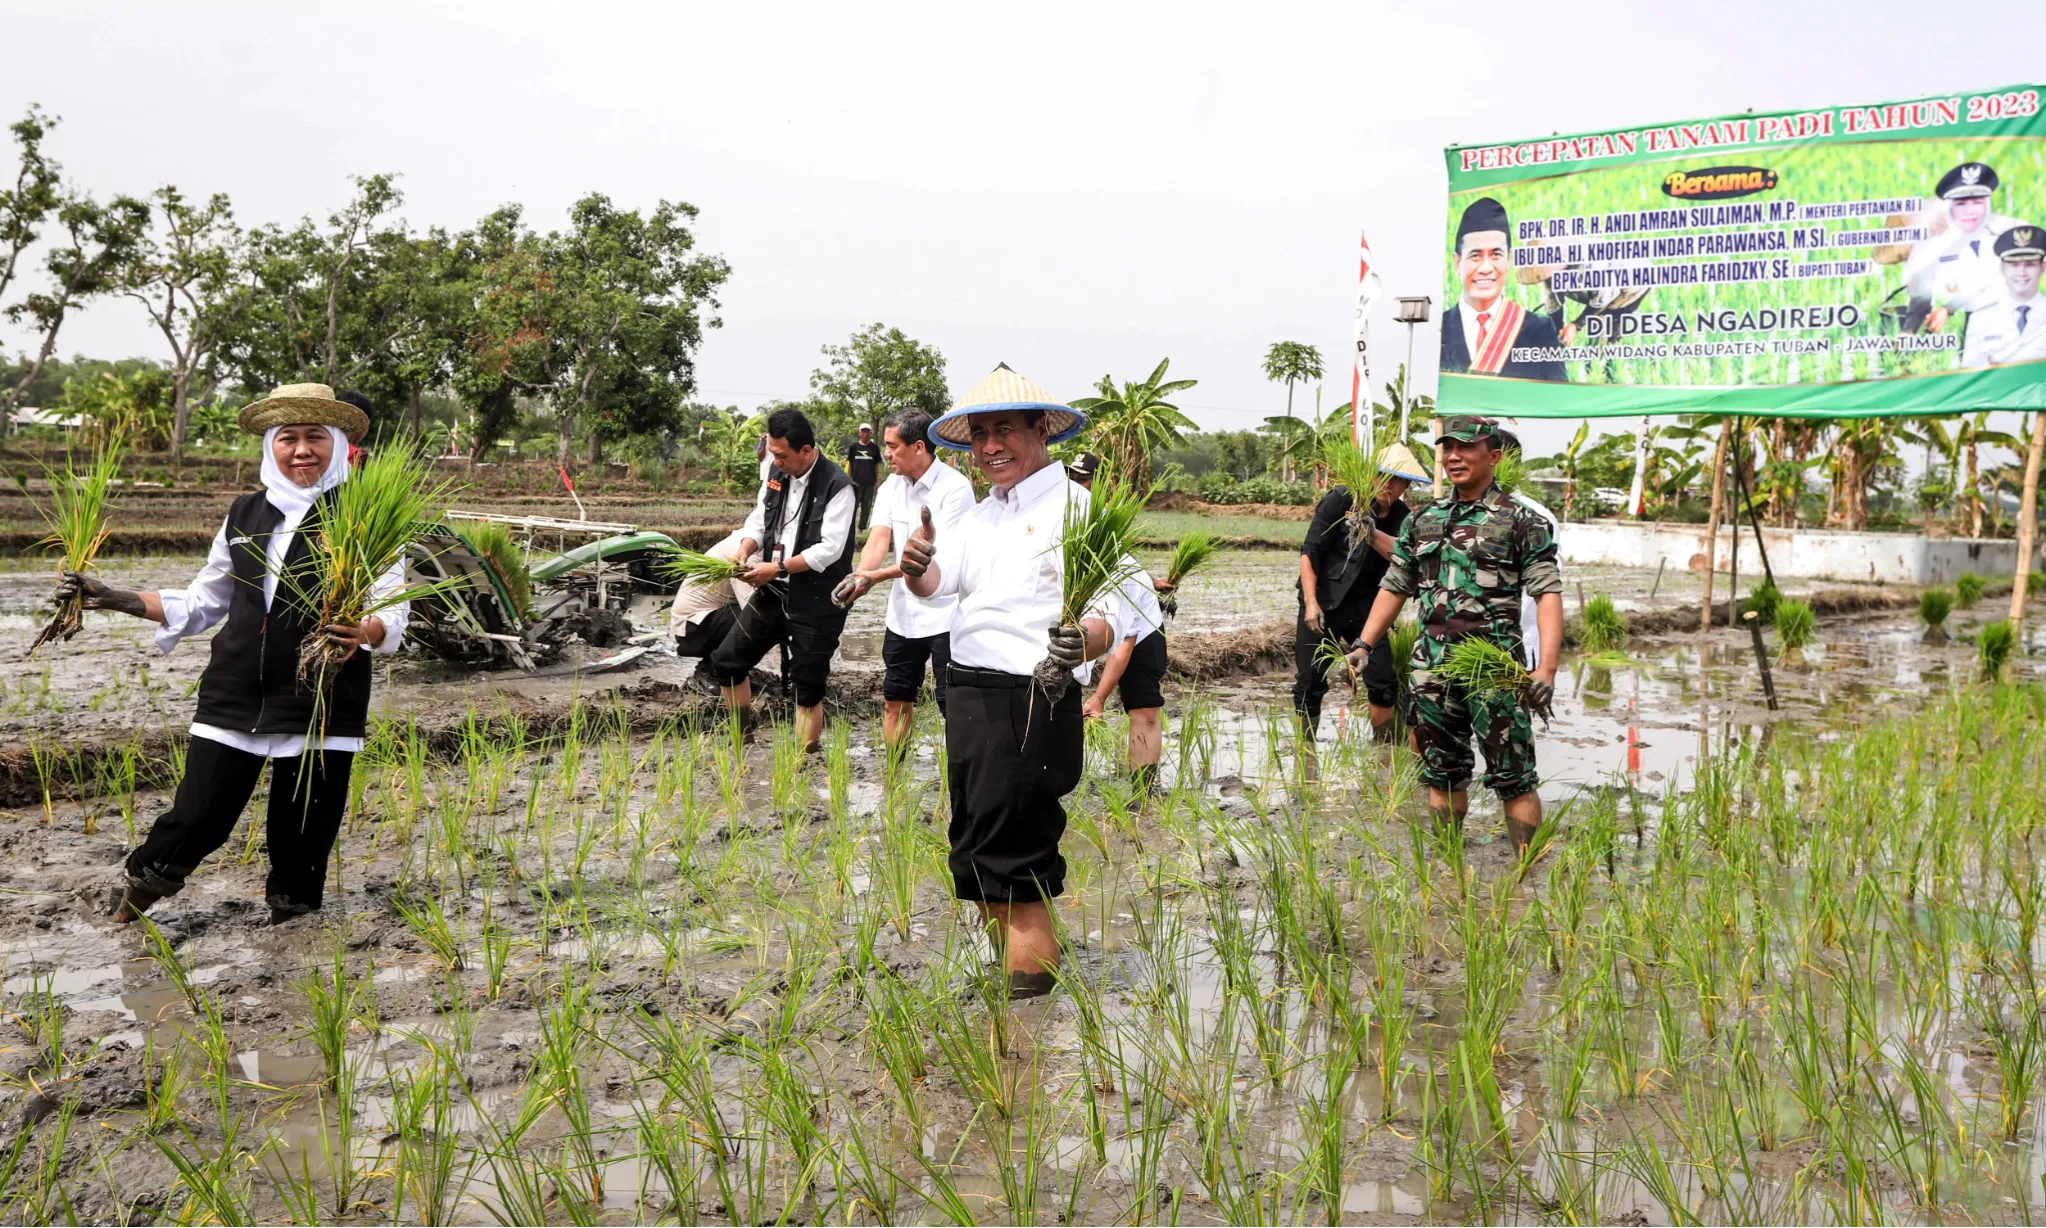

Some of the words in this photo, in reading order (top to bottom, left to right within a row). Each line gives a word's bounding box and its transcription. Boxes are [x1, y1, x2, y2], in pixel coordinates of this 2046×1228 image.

[1461, 134, 1636, 170] PERCEPATAN
[1645, 122, 1747, 152] TANAM
[1758, 113, 1833, 140] PADI
[1842, 100, 1958, 132] TAHUN
[1969, 92, 2037, 120] 2023
[1519, 221, 1546, 239] BPK.
[1549, 219, 1568, 237] DR.
[1572, 218, 1587, 235] IR.
[1590, 216, 1601, 234] H.
[1605, 213, 1636, 233] ANDI
[1639, 209, 1687, 230] AMRAN
[1691, 204, 1765, 227] SULAIMAN,
[1769, 202, 1795, 221] M.P.
[1805, 204, 1846, 219] MENTERI
[1849, 200, 1902, 216] PERTANIAN
[1905, 199, 1916, 212] RI
[1514, 248, 1534, 266] IBU
[1537, 246, 1565, 264] DRA.
[1568, 244, 1585, 262] HJ.
[1588, 240, 1649, 262] KHOFIFAH
[1653, 237, 1694, 257] INDAR
[1698, 231, 1789, 254] PARAWANSA,
[1793, 228, 1828, 248] M.SI.
[1838, 231, 1890, 246] GUBERNUR
[1893, 228, 1920, 243] JATIM
[1553, 271, 1582, 290] BPK.
[1584, 269, 1629, 288] ADITYA
[1633, 265, 1698, 286] HALINDRA
[1701, 261, 1769, 282] FARIDZKY,
[1772, 260, 1789, 278] SE
[1798, 263, 1832, 277] BUPATI
[1835, 261, 1867, 275] TUBAN
[1586, 316, 1613, 336] DI
[1621, 313, 1688, 335] DESA
[1697, 305, 1859, 333] NGADIREJO
[1511, 346, 1599, 362] KECAMATAN
[1603, 345, 1668, 358] WIDANG
[1672, 342, 1766, 357] KABUPATEN
[1772, 340, 1829, 354] TUBAN
[1847, 337, 1892, 351] JAWA
[1897, 334, 1957, 349] TIMUR
